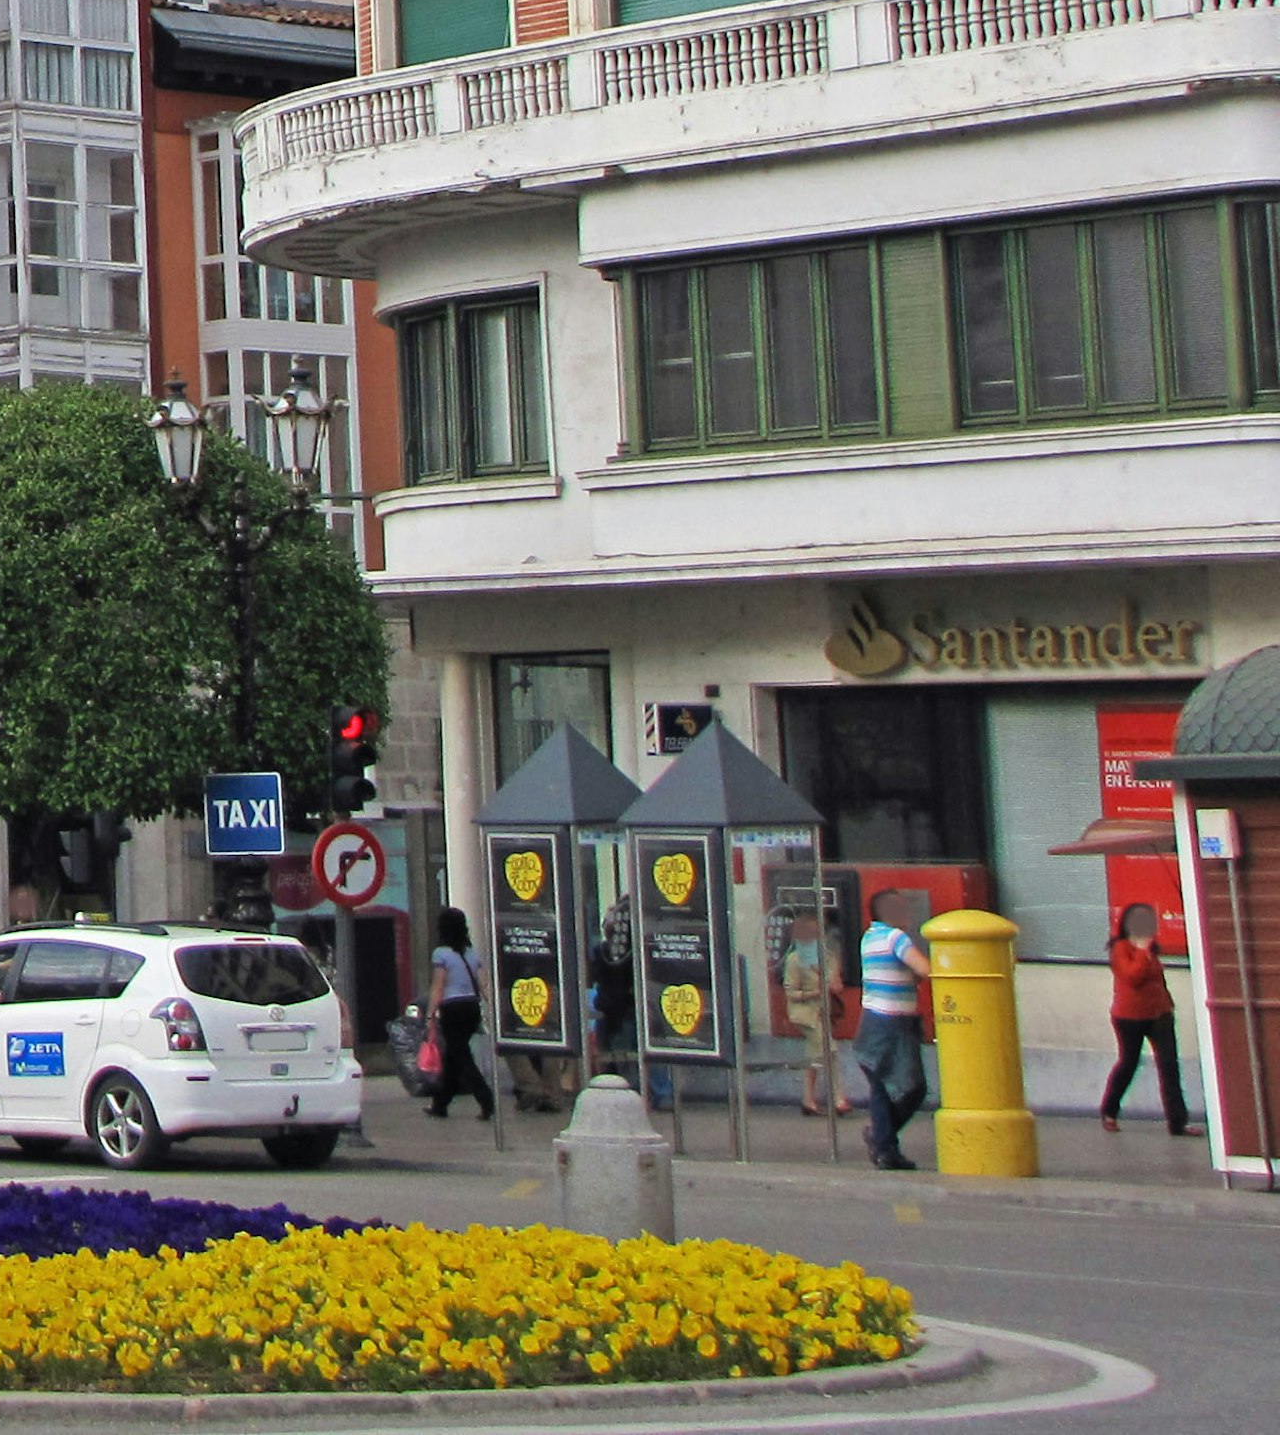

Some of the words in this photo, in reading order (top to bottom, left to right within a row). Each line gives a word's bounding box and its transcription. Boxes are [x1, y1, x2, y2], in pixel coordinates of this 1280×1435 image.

[910, 598, 1200, 667] Santander
[1105, 774, 1122, 787] EN
[213, 799, 276, 828] TAXI
